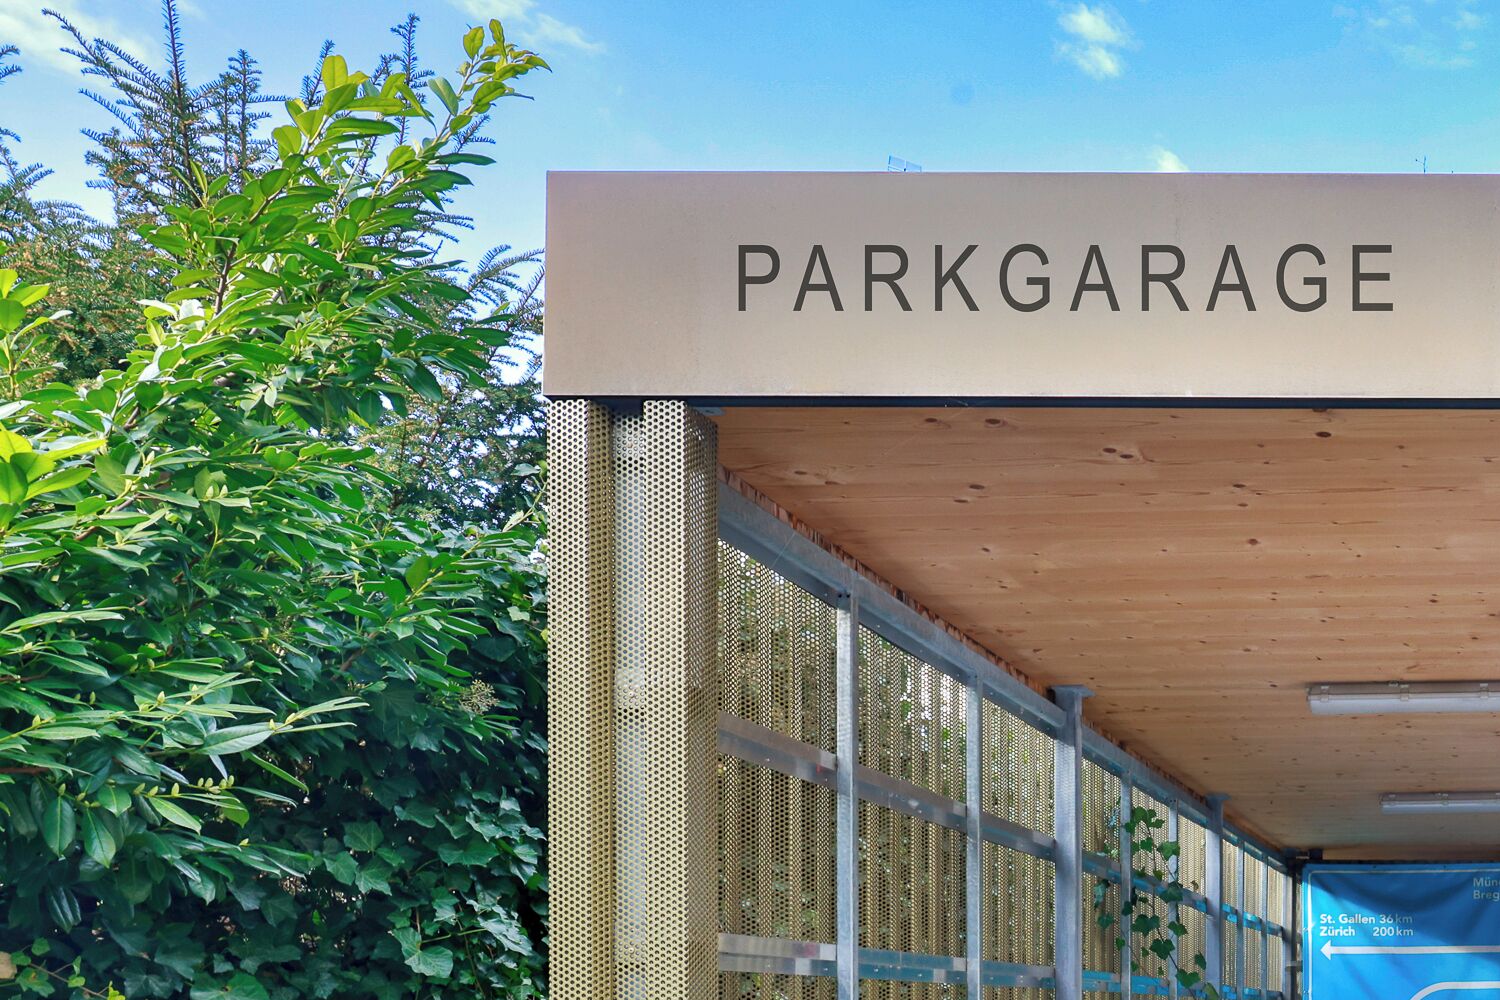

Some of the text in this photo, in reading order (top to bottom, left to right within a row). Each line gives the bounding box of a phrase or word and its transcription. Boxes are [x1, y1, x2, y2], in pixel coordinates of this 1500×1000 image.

[736, 243, 1394, 312] PARKGARAGE
[1320, 914, 1336, 924] St.
[1339, 914, 1376, 924] Gallen
[1320, 926, 1356, 937] Zürich
